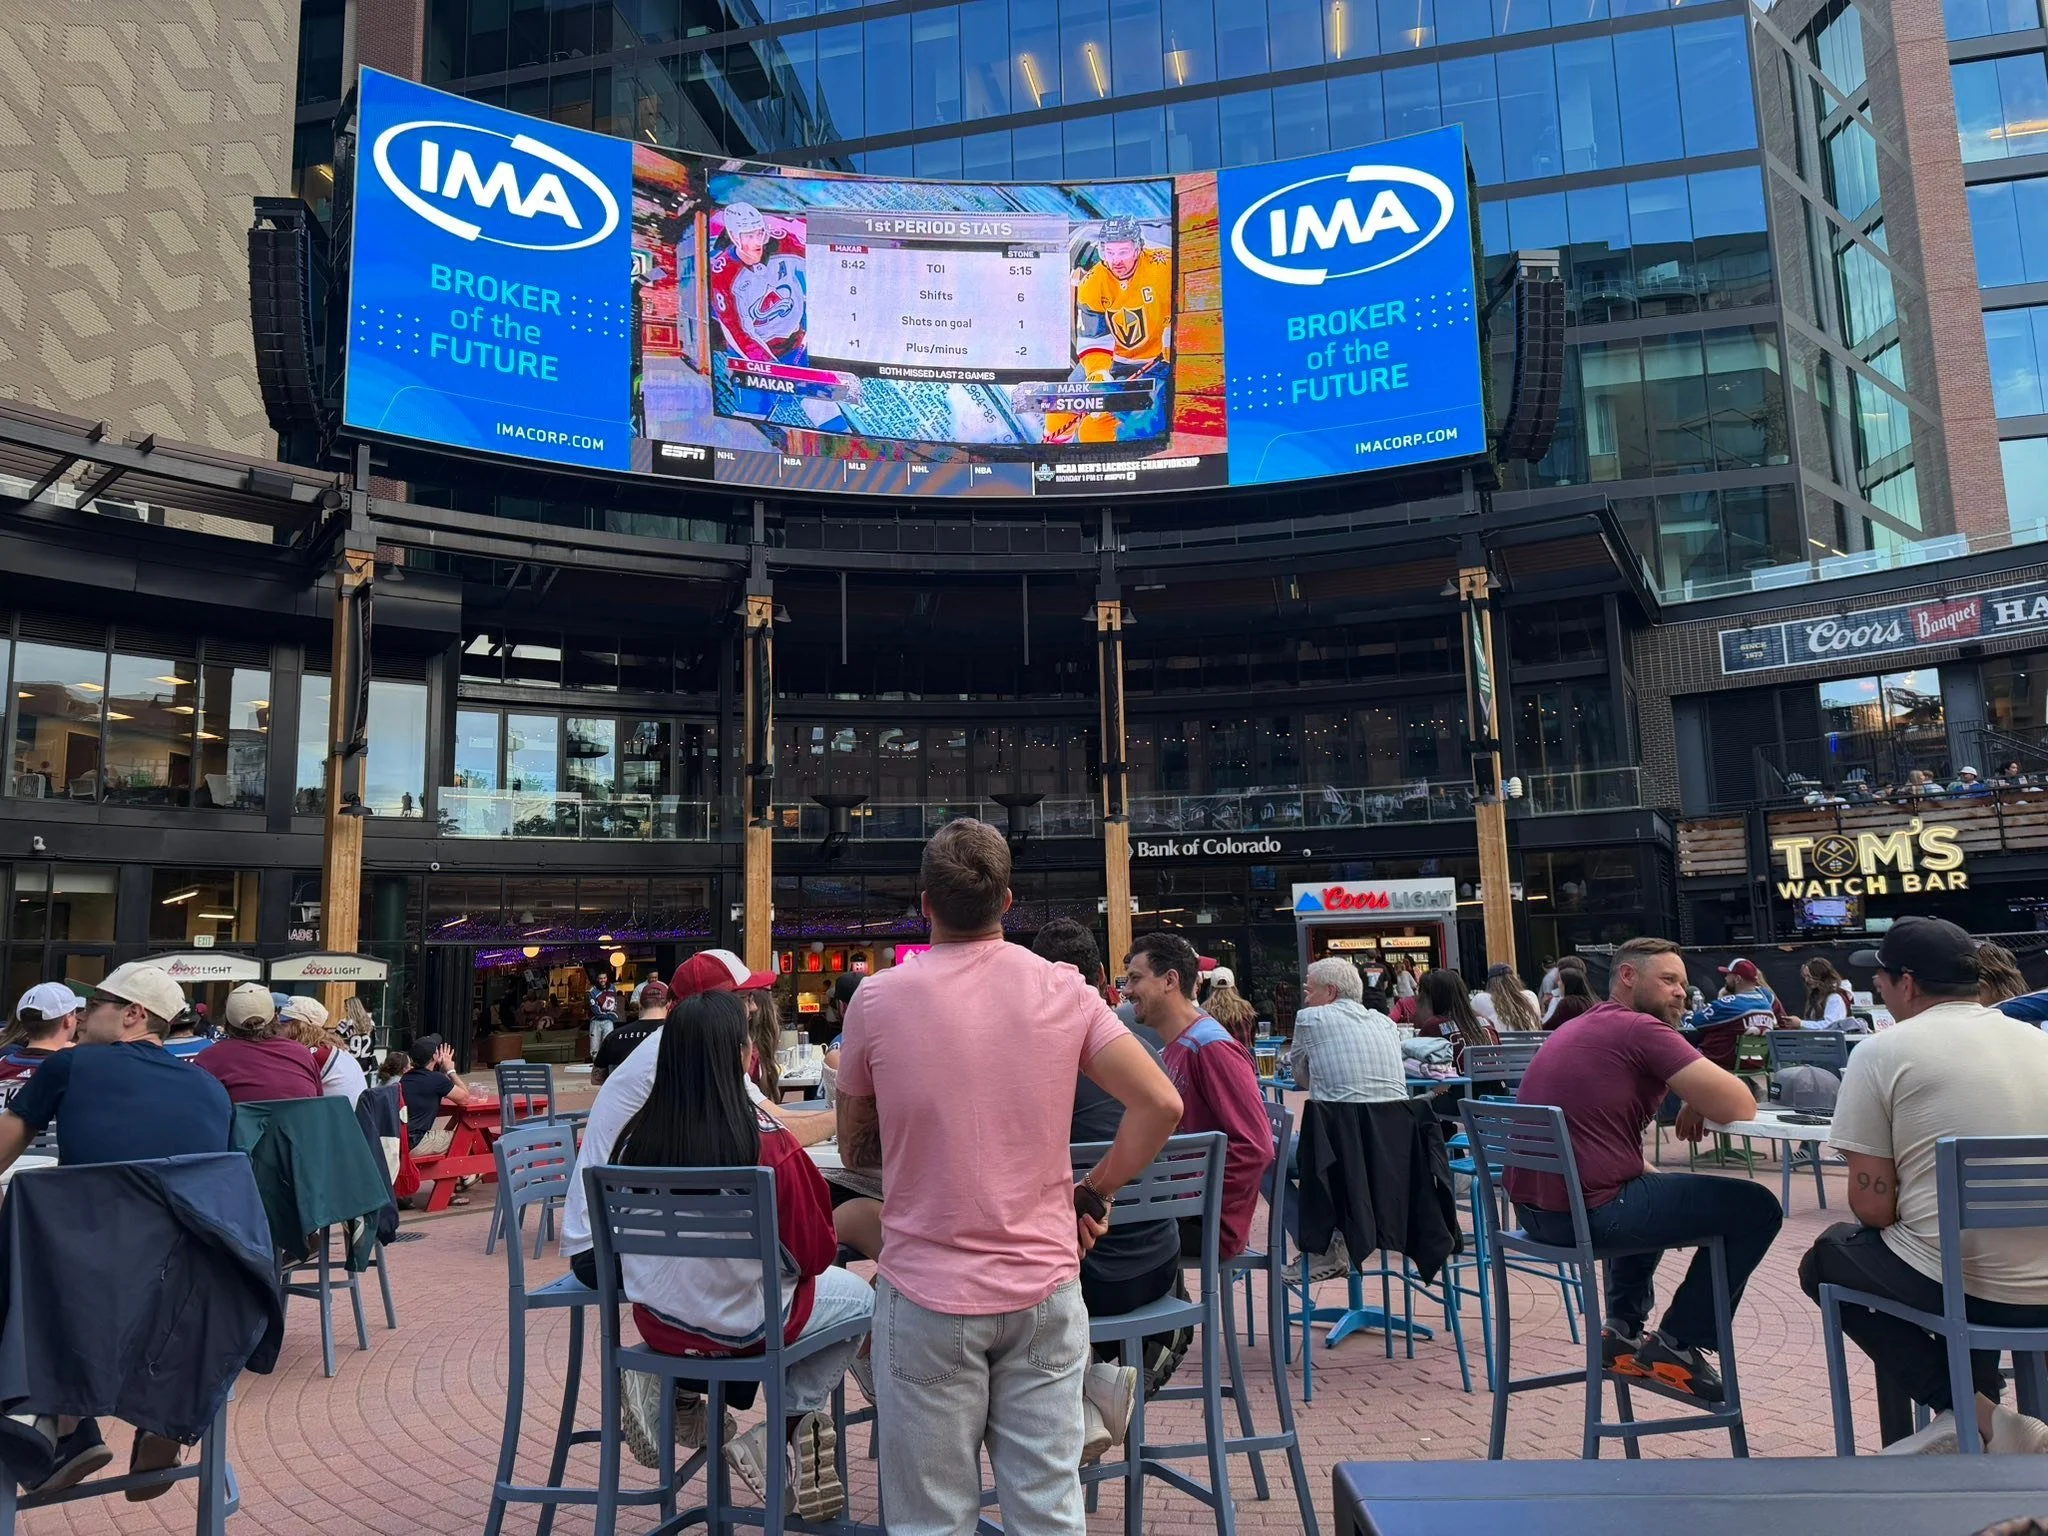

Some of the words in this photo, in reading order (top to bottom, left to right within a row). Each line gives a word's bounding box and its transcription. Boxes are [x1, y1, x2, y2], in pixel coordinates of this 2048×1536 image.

[420, 140, 583, 229] IMA
[865, 218, 891, 233] 1st
[894, 221, 956, 235] PERIOD
[959, 222, 1012, 236] STATS
[1270, 189, 1420, 257] IMA
[841, 260, 866, 270] 8:42
[926, 264, 945, 274] TOI
[1009, 266, 1032, 276] 5:15
[431, 263, 561, 316] BROKER
[850, 286, 857, 295] 8
[919, 290, 953, 301] Shifts
[1017, 293, 1024, 302] 6
[851, 313, 857, 322] 1
[901, 316, 932, 327] Shots
[935, 319, 947, 328] on
[950, 318, 972, 330] goal
[1018, 320, 1024, 329] 1
[1288, 300, 1406, 341] BROKER
[451, 307, 484, 332] of
[491, 313, 541, 345] the
[849, 339, 860, 348] +1
[906, 342, 968, 355] Plus/minus
[430, 332, 559, 381] FUTURE
[1015, 346, 1027, 356] -2
[1307, 342, 1336, 370] of
[1342, 338, 1389, 365] the
[747, 362, 772, 373] CALE
[879, 367, 902, 376] BOTH
[903, 368, 934, 378] MISSED
[936, 370, 957, 379] LAST
[958, 372, 964, 380] 2
[965, 372, 995, 380] GAMES
[747, 375, 795, 394] MAKAR
[1057, 383, 1090, 393] MARK
[1292, 363, 1409, 404] FUTURE
[1056, 397, 1104, 410] STONE
[496, 422, 604, 451] IMACORP.COM
[1355, 428, 1458, 454] IMACORP.COM
[661, 444, 706, 460] ESPN
[717, 451, 736, 461] NHL
[783, 457, 802, 466] NBA
[849, 462, 867, 471] MLB
[1102, 461, 1140, 473] LACROSSE
[1141, 457, 1200, 471] CHAMPIONSHIP
[912, 465, 930, 474] NHL
[975, 466, 992, 475] NBA
[1917, 601, 1976, 639] Banquet
[1805, 620, 1904, 652] Coors
[1137, 839, 1179, 857] Bank
[1182, 838, 1200, 856] of
[1203, 835, 1281, 854] Colorado
[1777, 875, 1887, 900] WATCH
[1902, 871, 1969, 893] BAR
[1322, 886, 1390, 911] Coors
[1391, 889, 1454, 909] LIGHT
[167, 962, 201, 976] Coors
[202, 966, 232, 975] LIGHT
[302, 962, 333, 976] Coors
[334, 966, 362, 975] LIGHT
[350, 1035, 371, 1058] 92
[1857, 1171, 1887, 1195] 96
